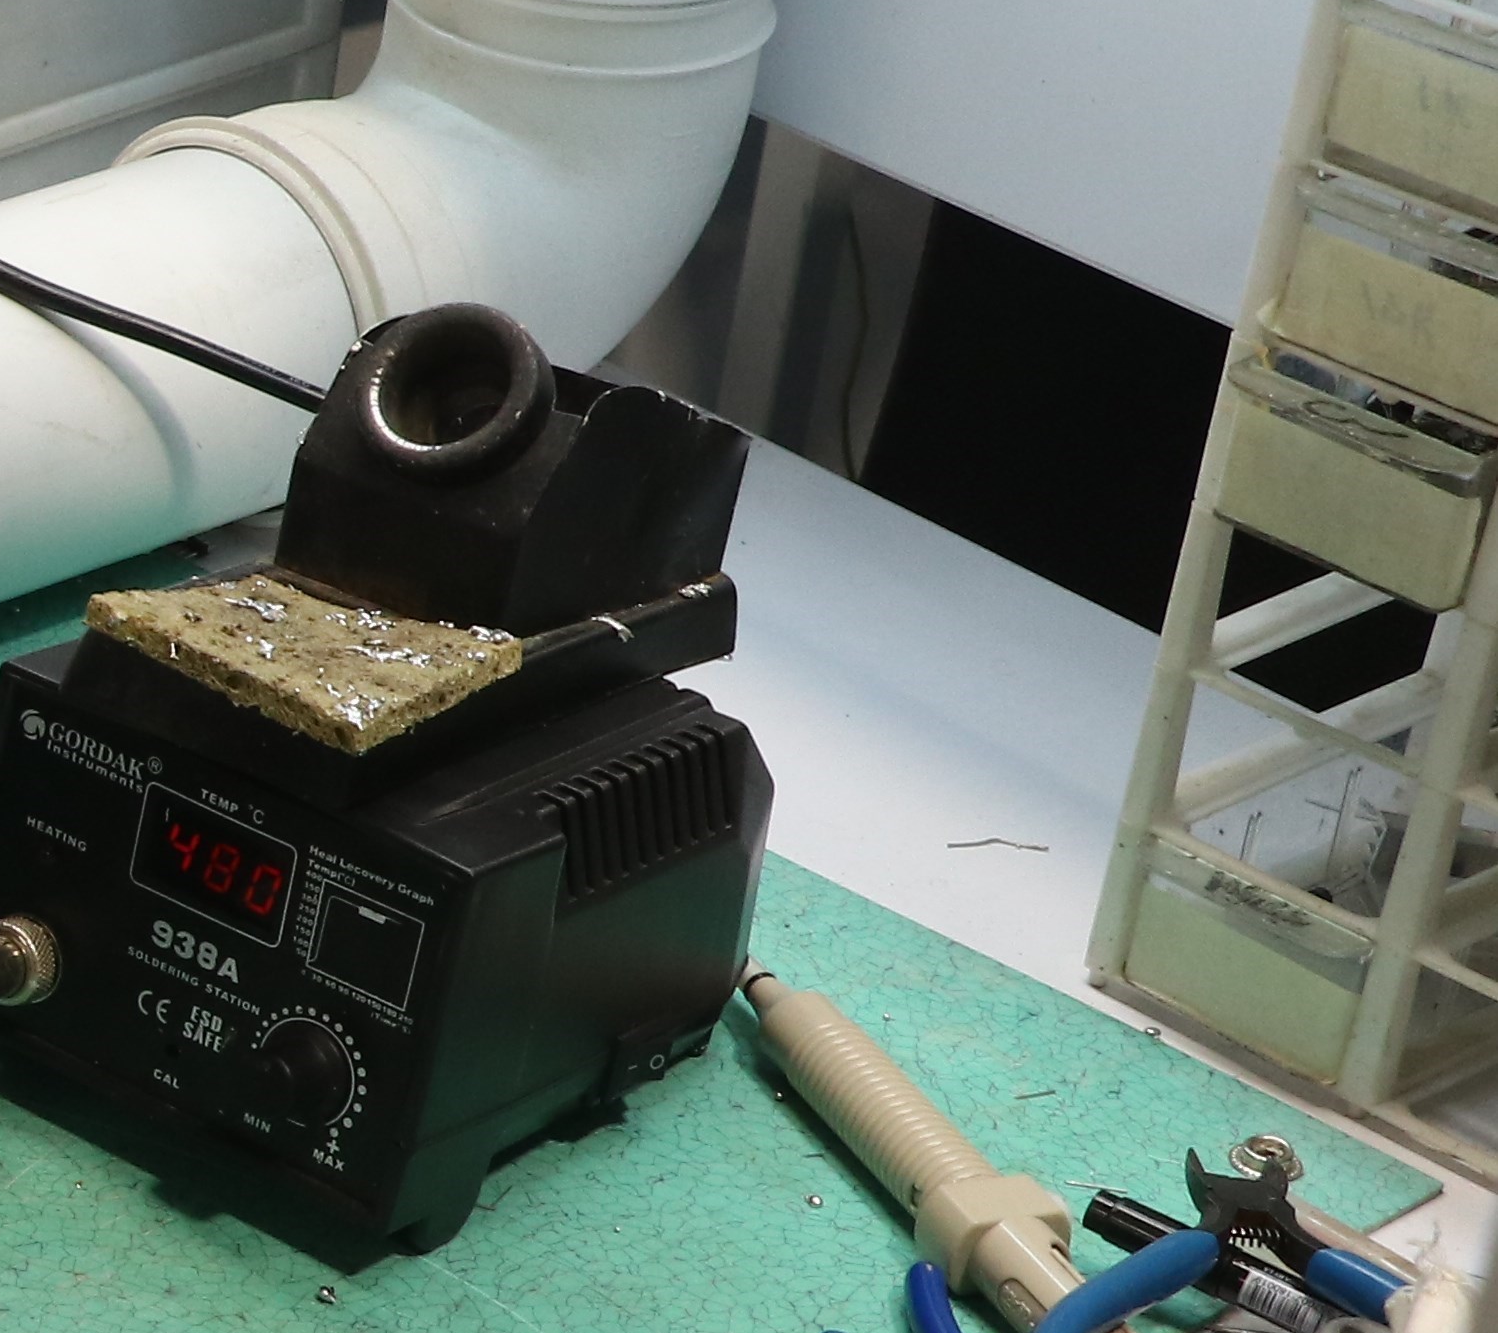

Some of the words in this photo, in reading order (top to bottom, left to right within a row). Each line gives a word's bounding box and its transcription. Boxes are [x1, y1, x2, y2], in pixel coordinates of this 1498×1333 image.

[47, 739, 144, 794] Instruments
[49, 722, 145, 781] GORDAK
[201, 788, 239, 813] TEMP
[26, 816, 88, 852] HEATING
[168, 822, 284, 916] 480
[397, 883, 435, 907] Graph
[151, 919, 239, 984] 938A
[127, 945, 199, 987] SOLDERING
[205, 982, 261, 1016] STATION
[190, 1005, 223, 1033] ESD
[182, 1022, 224, 1054] SAFE
[153, 1068, 180, 1090] CAL
[243, 1112, 272, 1134] MIN
[312, 1148, 345, 1172] MAX
